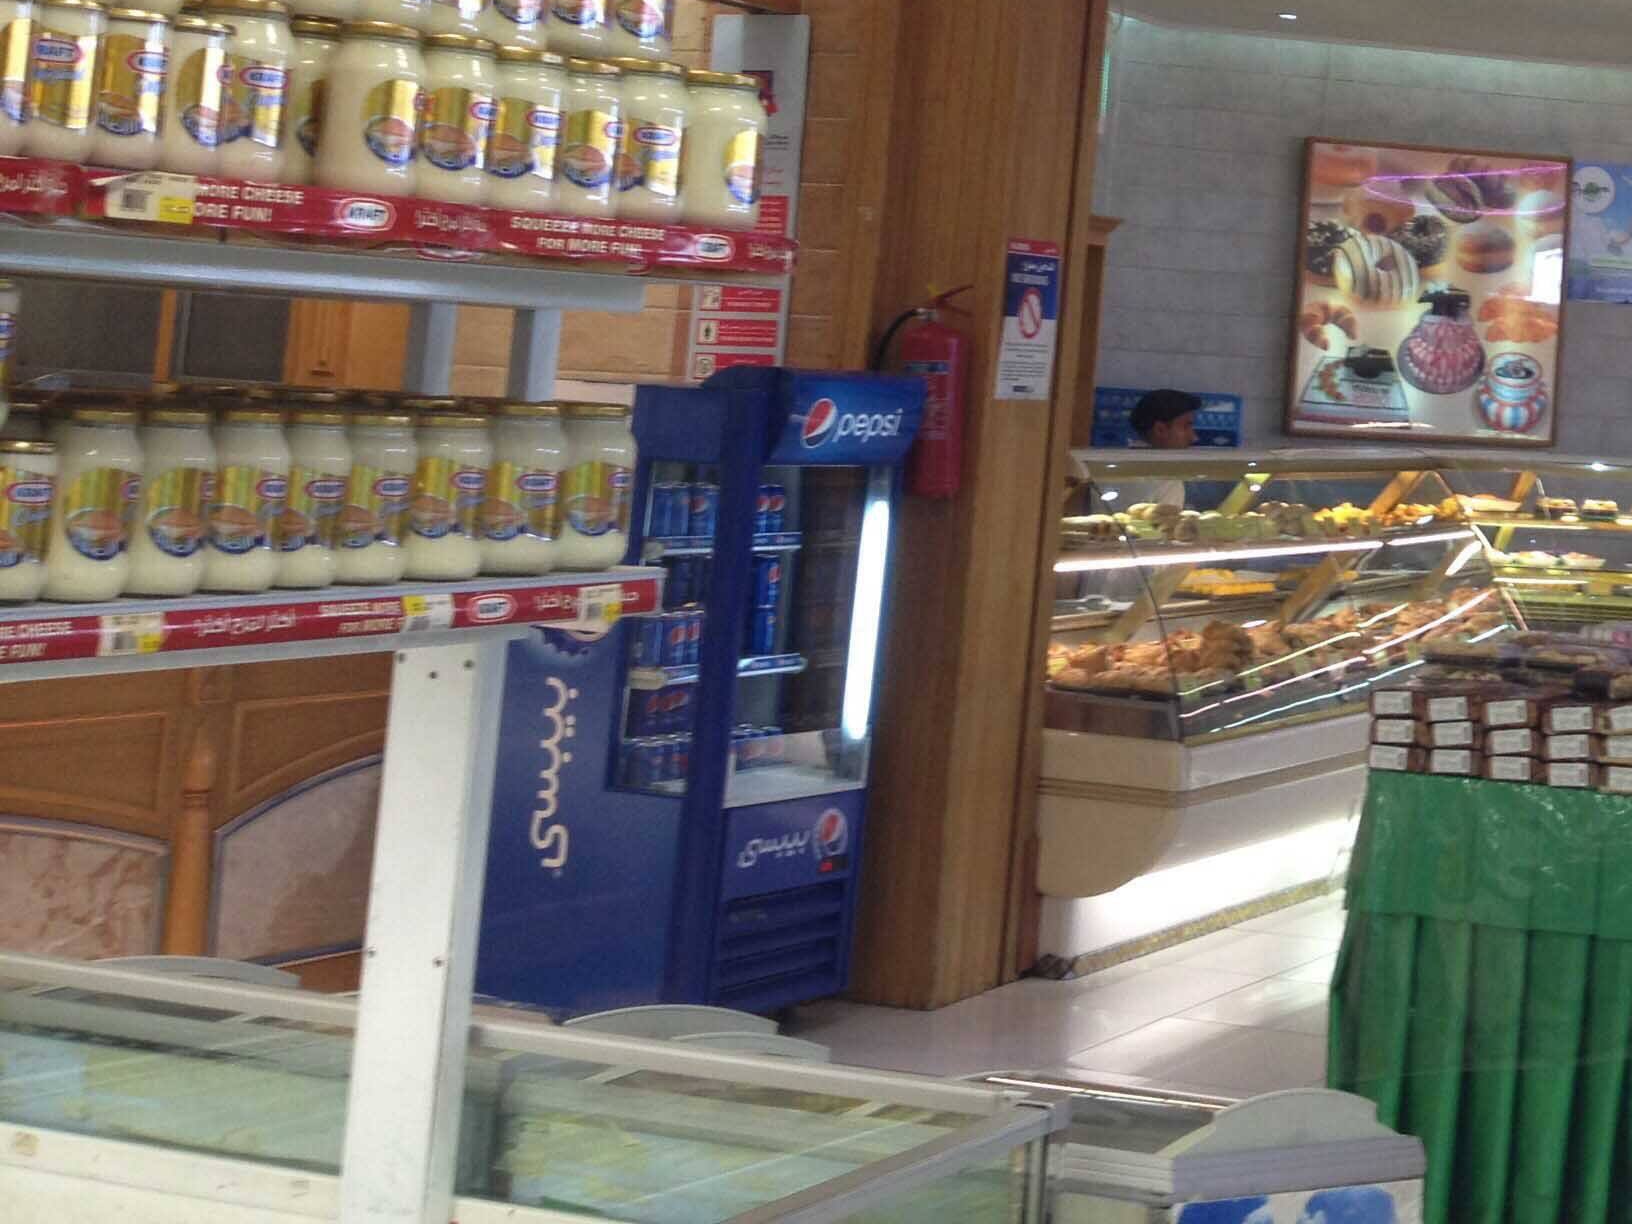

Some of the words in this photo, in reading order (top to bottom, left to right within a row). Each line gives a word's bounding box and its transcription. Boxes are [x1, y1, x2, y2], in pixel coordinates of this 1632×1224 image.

[241, 187, 304, 205] CHEESE
[195, 202, 230, 219] ORE
[511, 216, 579, 233] SQUEEZE
[579, 222, 617, 236] MORE
[618, 225, 666, 241] CHEESE
[536, 237, 565, 249] FOR
[566, 238, 609, 253] MORE
[832, 408, 904, 443] pepsi
